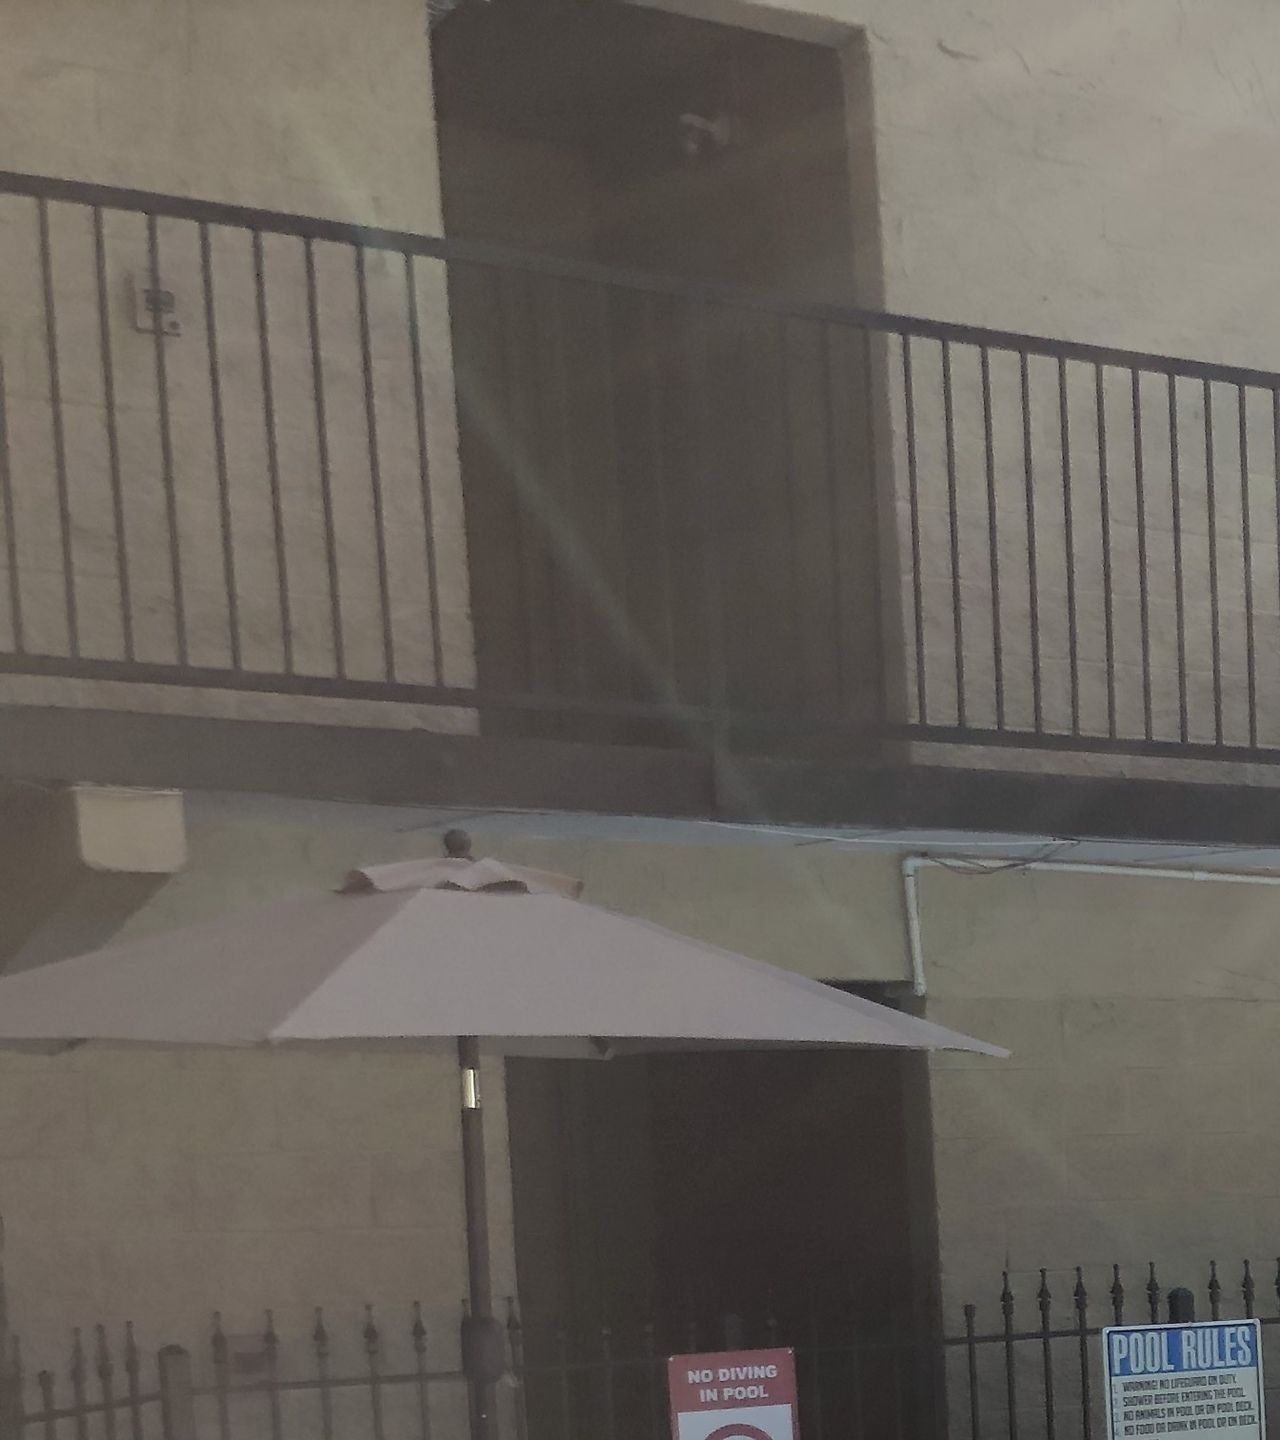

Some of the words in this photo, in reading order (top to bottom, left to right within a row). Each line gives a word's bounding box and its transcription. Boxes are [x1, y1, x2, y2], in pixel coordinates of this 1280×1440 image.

[1112, 1332, 1174, 1373] POOL
[1182, 1326, 1252, 1369] RULES
[688, 1370, 713, 1383] NO
[719, 1365, 777, 1381] DIVING
[700, 1389, 718, 1402] IN
[724, 1386, 769, 1400] POOL
